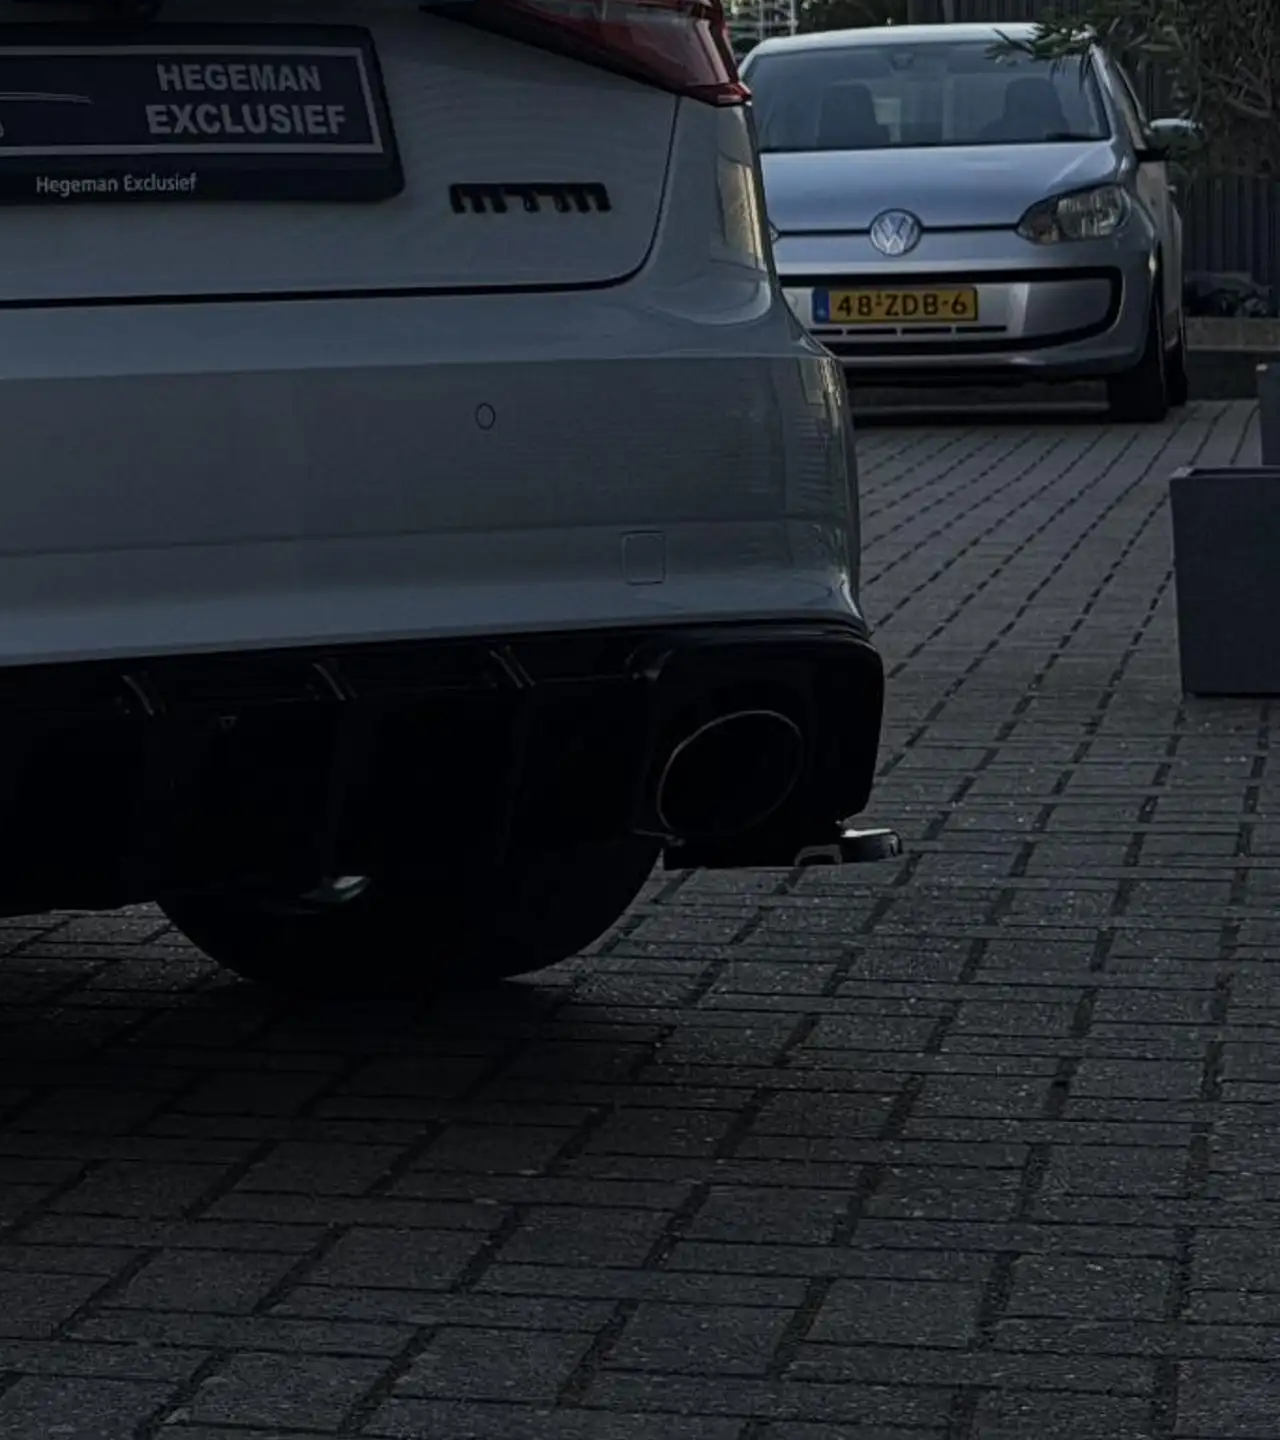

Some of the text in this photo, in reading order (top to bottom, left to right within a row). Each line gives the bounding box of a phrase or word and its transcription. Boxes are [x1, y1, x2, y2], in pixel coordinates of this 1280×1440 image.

[156, 63, 322, 92] HEGEMAN
[145, 103, 347, 135] EXCLUSIEF
[35, 172, 199, 198] Hegeman Exclusief
